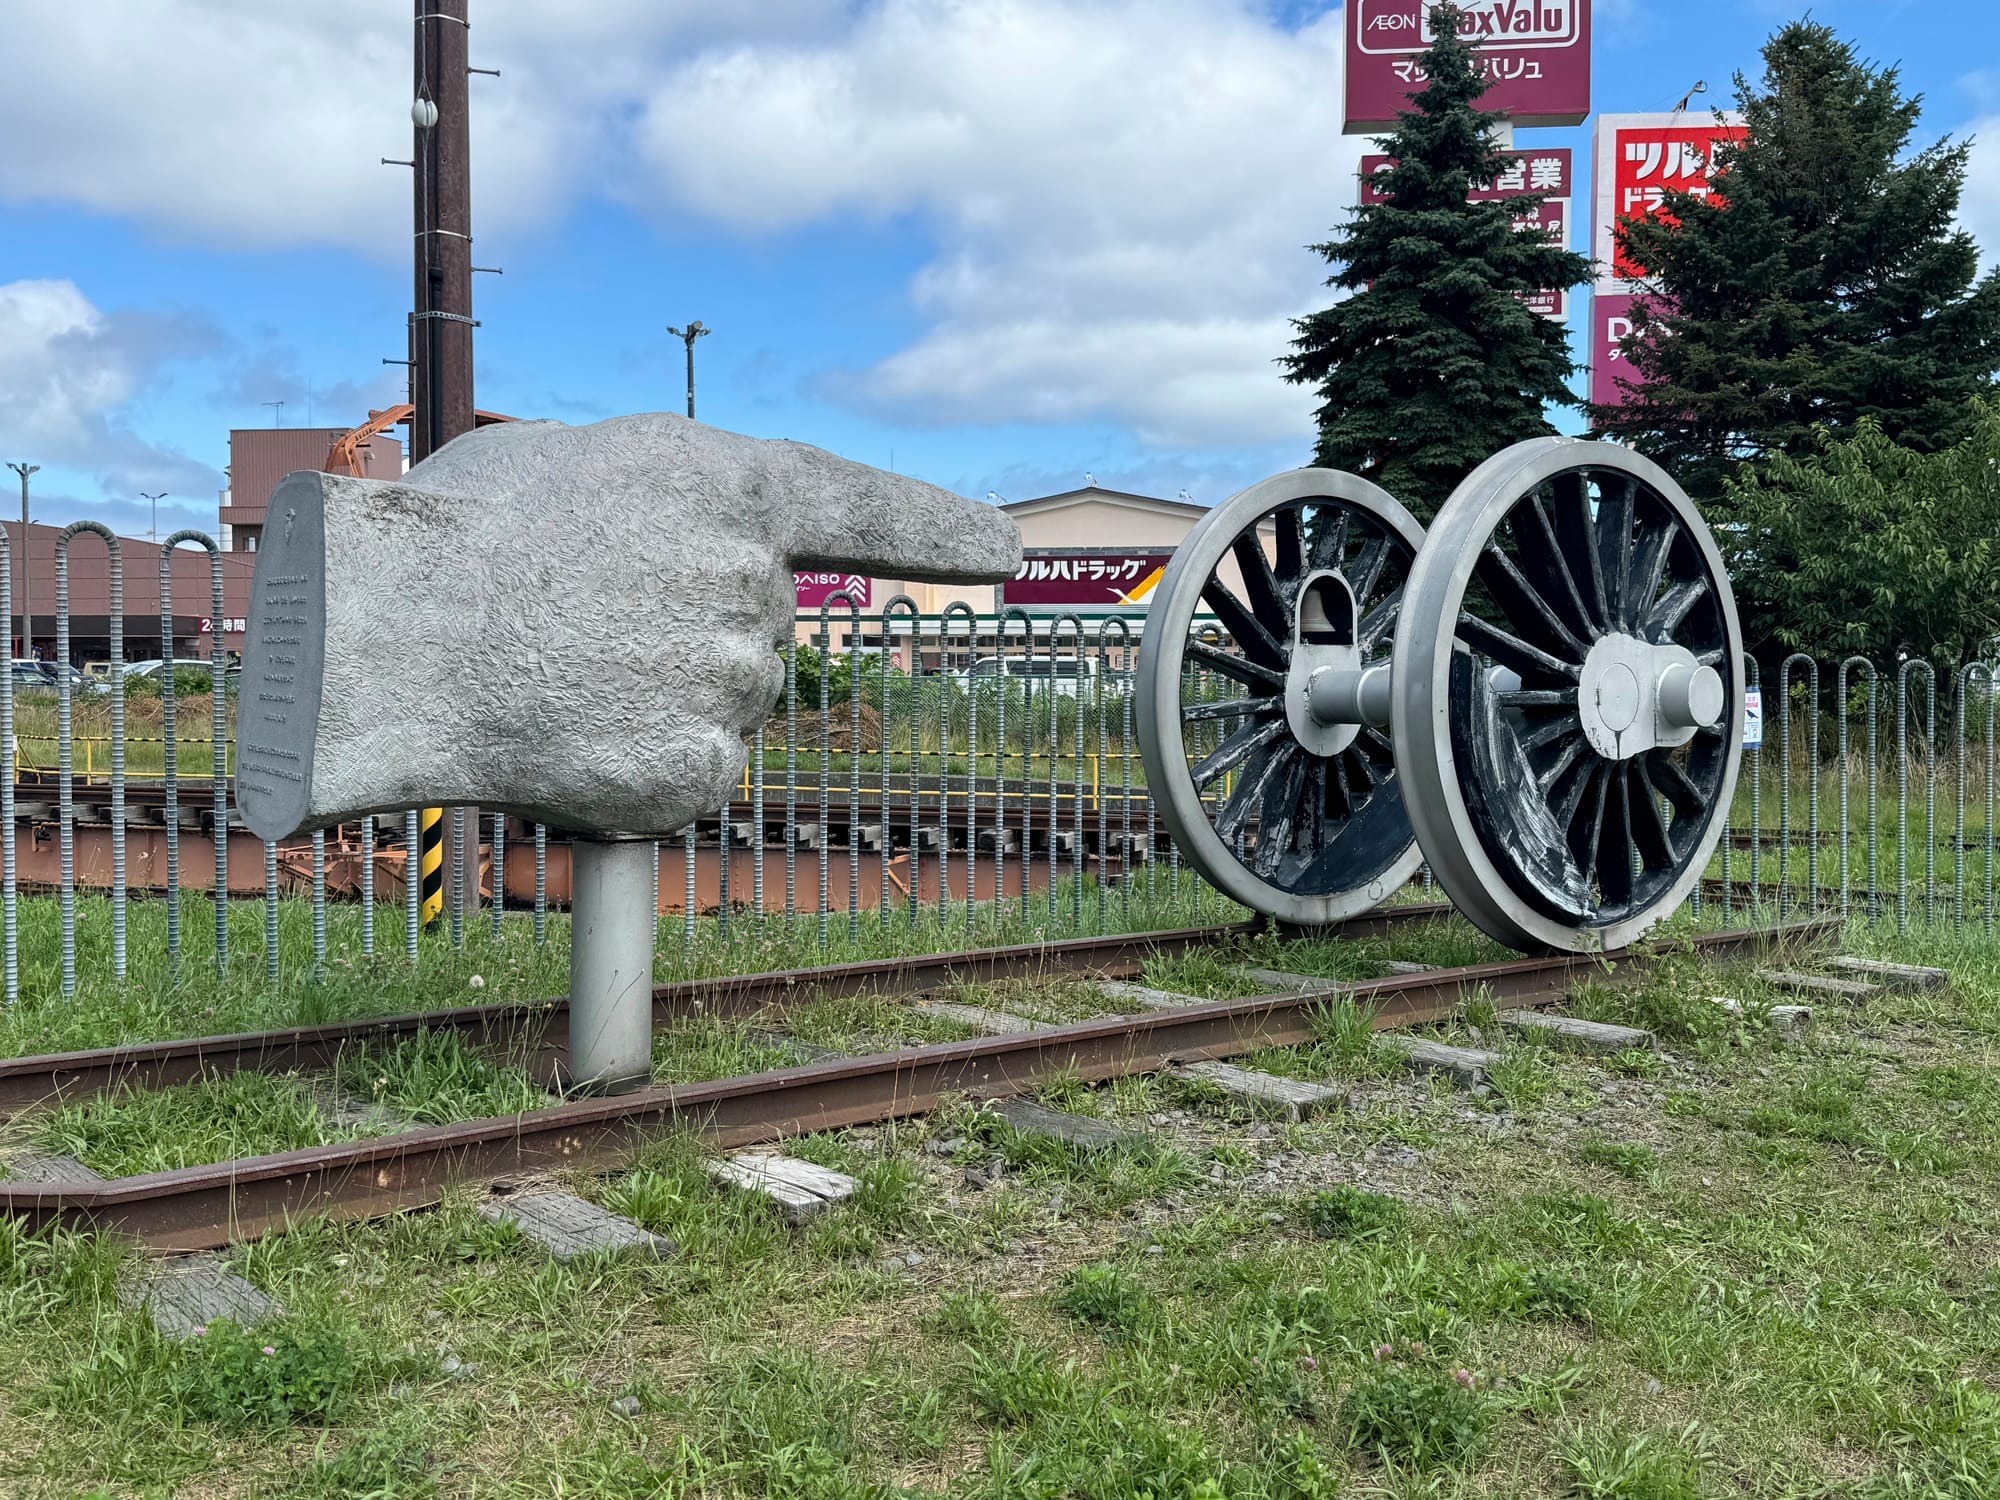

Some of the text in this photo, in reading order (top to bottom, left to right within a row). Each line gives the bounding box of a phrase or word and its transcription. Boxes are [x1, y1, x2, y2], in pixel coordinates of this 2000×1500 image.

[1391, 57, 1543, 83] マッバリュ
[201, 618, 246, 632] 2時間
